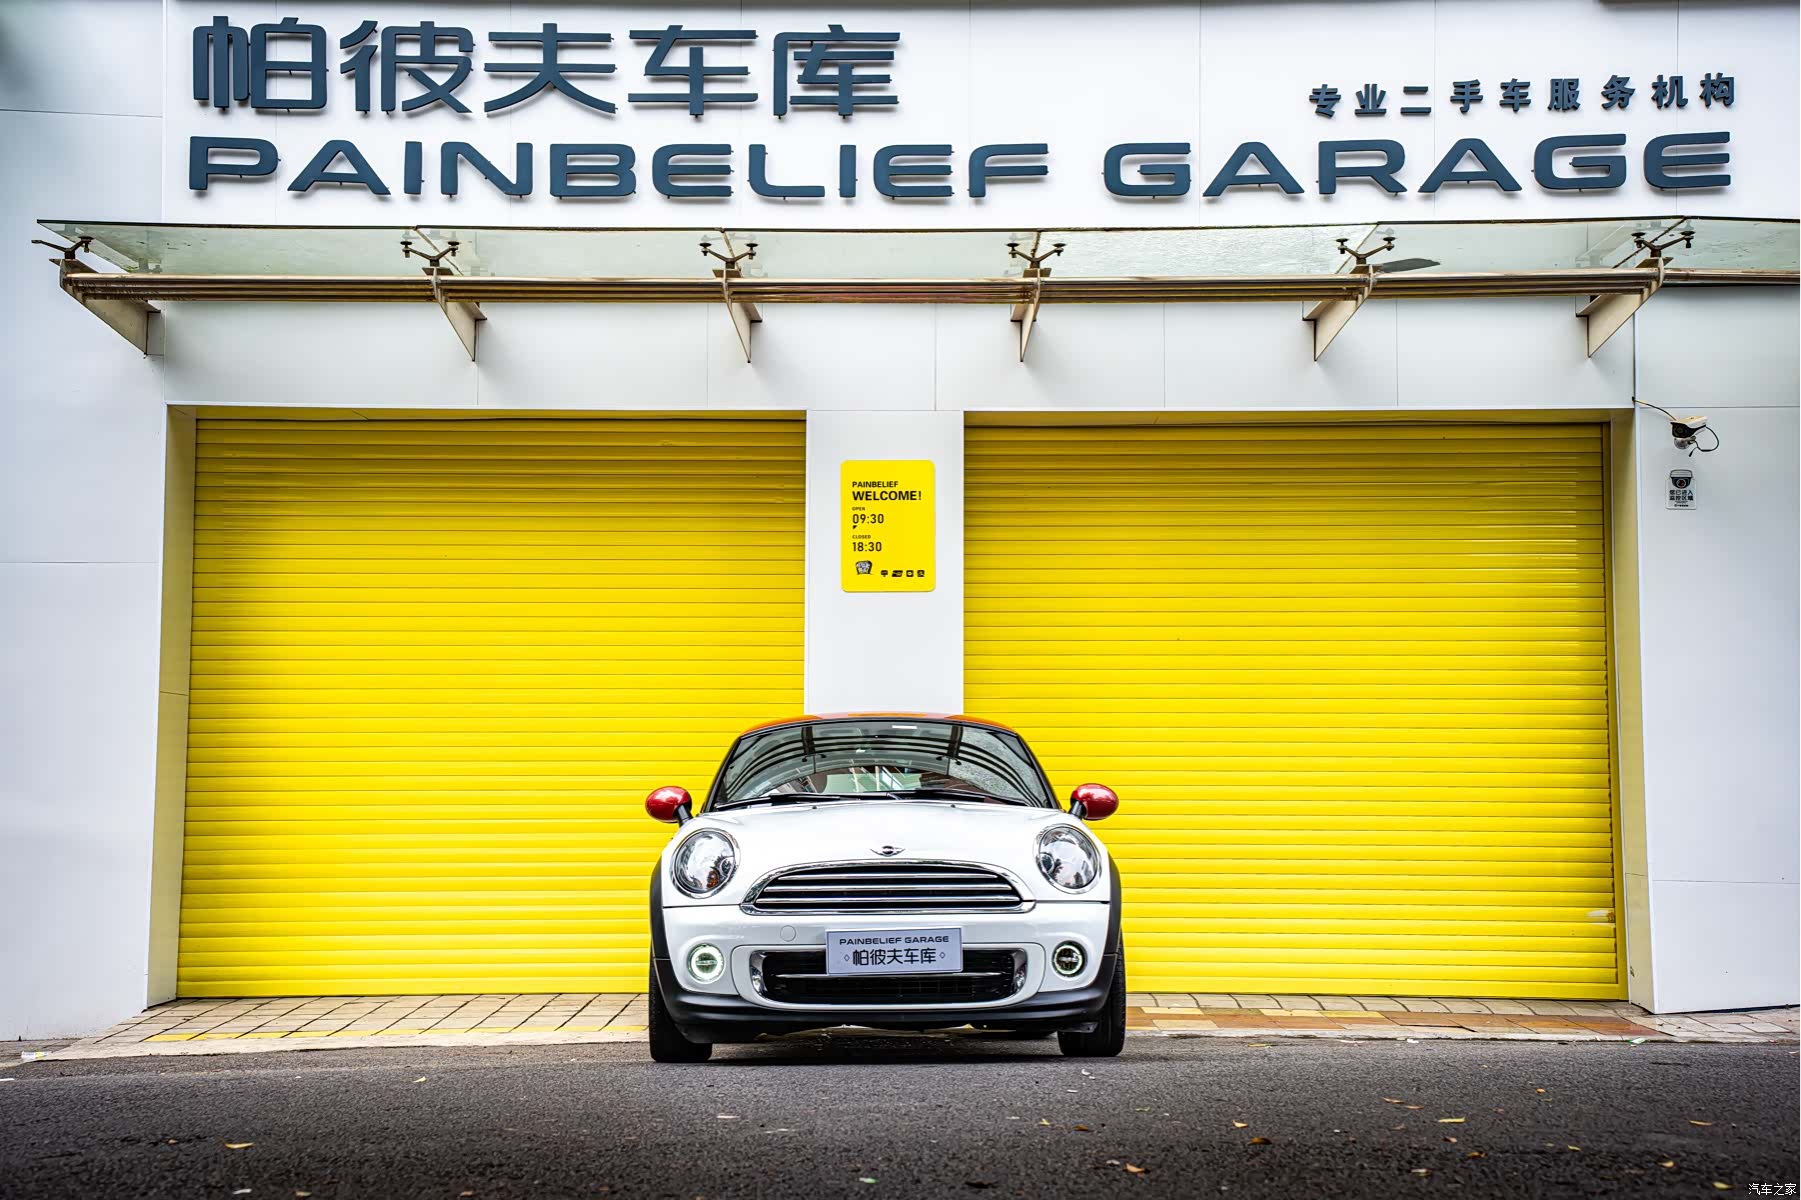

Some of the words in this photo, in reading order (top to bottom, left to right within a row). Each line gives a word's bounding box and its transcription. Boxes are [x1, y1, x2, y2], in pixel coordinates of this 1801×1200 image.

[192, 16, 901, 117] 帕彼夫车库
[1309, 72, 1736, 118] 专业二手车服务机构
[188, 135, 1049, 200] PAINBELIEF
[1103, 131, 1731, 197] GARAGE
[852, 480, 899, 488] PAINBELIEF
[852, 490, 922, 501] WELCOME!
[852, 513, 884, 524] 09:30
[852, 541, 882, 552] 18:30
[839, 937, 902, 945] PAINBELIEF
[904, 935, 950, 944] GARAGE
[852, 947, 937, 966] 帕彼夫车库
